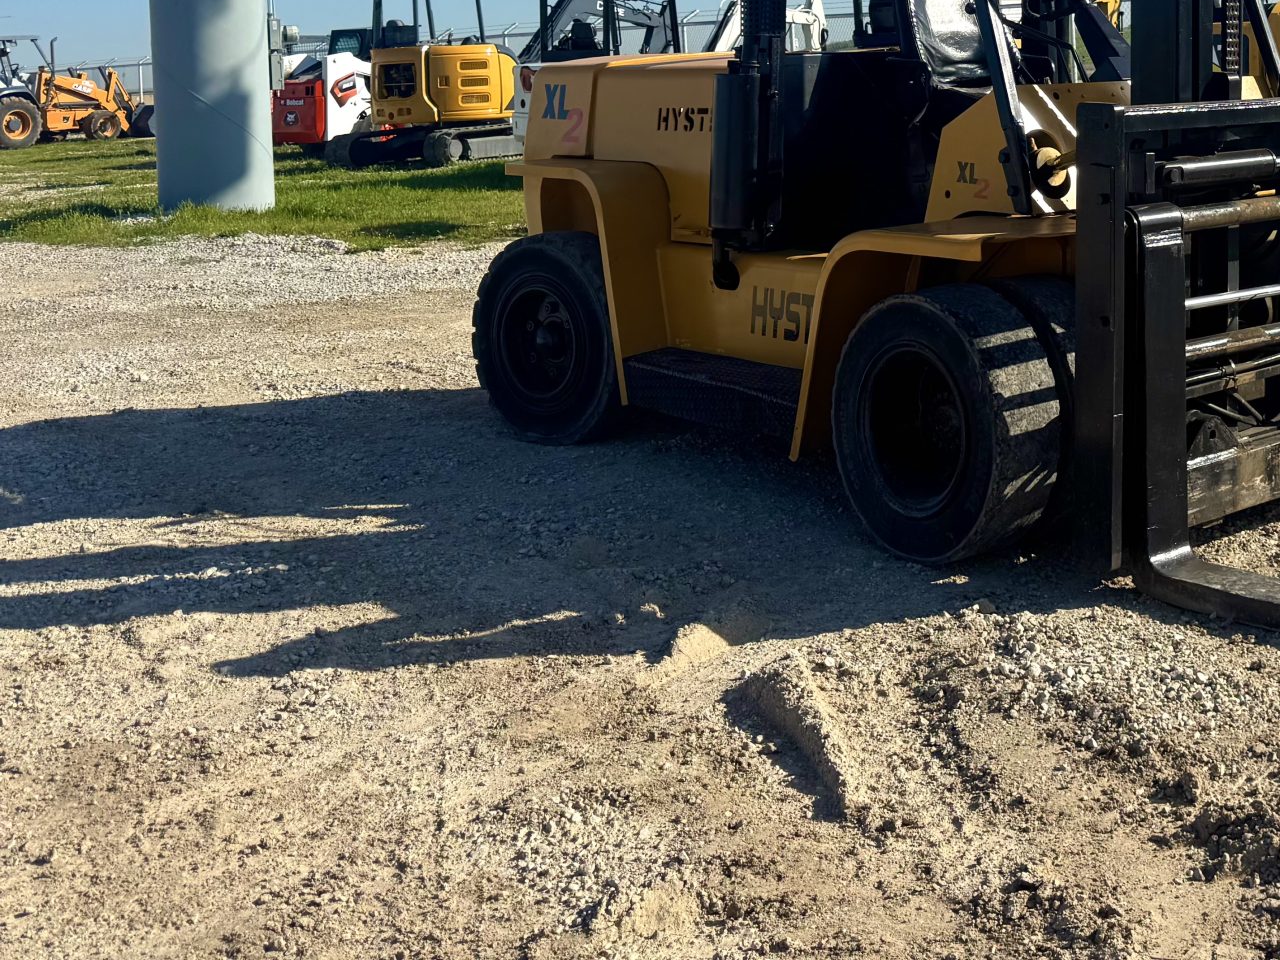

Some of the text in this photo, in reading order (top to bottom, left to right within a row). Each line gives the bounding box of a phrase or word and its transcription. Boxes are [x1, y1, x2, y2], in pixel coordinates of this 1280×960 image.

[541, 83, 569, 120] XL
[657, 107, 712, 133] HYST
[956, 160, 977, 185] XL
